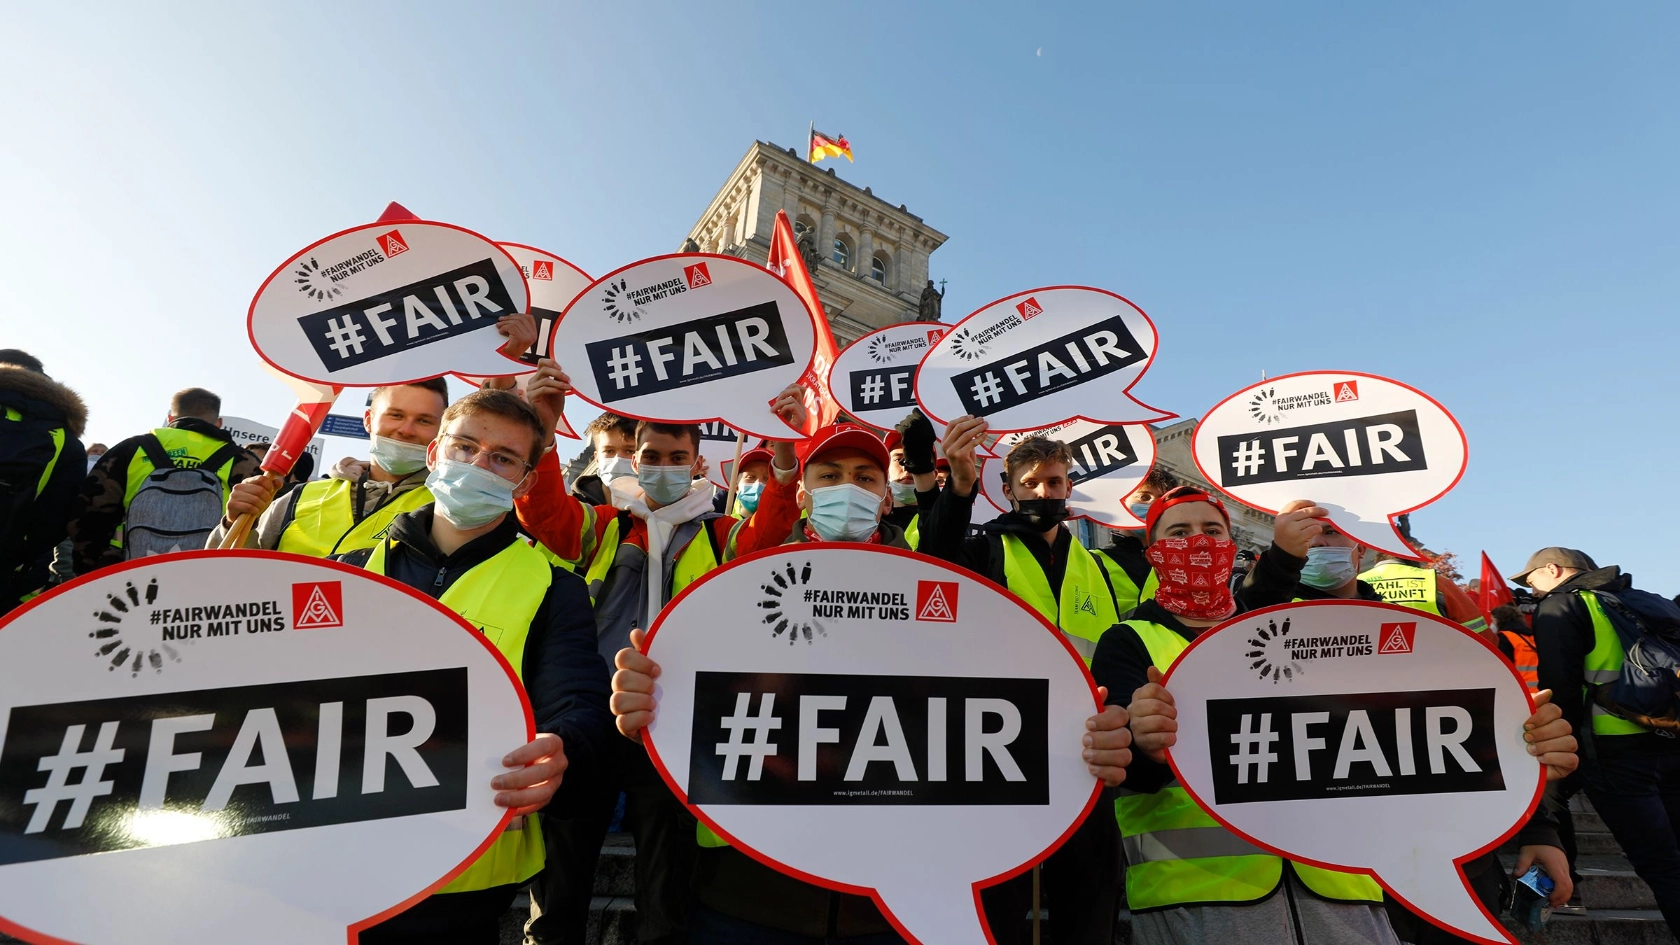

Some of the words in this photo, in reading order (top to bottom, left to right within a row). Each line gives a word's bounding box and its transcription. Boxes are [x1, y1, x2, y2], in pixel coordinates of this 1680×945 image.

[320, 248, 379, 278] #FAIRWANDEL
[330, 270, 350, 283] NUR
[350, 263, 368, 275] MIT
[367, 254, 385, 268] UNS
[626, 278, 684, 300] #FAIRWANDEL
[634, 295, 652, 306] NUR
[653, 290, 668, 301] MIT
[670, 284, 687, 296] UNS
[324, 274, 504, 359] #FAIR
[970, 314, 1018, 342] #FAIRWANDEL
[885, 337, 926, 349] #FAIRWANDEL
[977, 335, 994, 345] NUR
[994, 328, 1007, 338] MIT
[1006, 318, 1022, 330] UNS
[606, 316, 780, 390] #FAIR
[970, 330, 1132, 408] #FAIR
[1272, 391, 1330, 405] #FAIRWANDEL
[1278, 403, 1295, 411] NUR
[1296, 400, 1312, 409] MIT
[1313, 397, 1331, 407] UNS
[1231, 423, 1412, 477] #FAIR
[1407, 580, 1426, 588] IST
[803, 589, 908, 606] #FAIRWANDEL
[150, 600, 282, 625] #FAIRWANDEL
[812, 604, 844, 618] NUR
[847, 605, 876, 619] MIT
[878, 606, 910, 620] UNS
[162, 624, 202, 641] NUR
[207, 620, 242, 638] MIT
[246, 616, 286, 634] UNS
[1283, 634, 1372, 650] #FAIRWANDEL
[1291, 649, 1318, 660] NUR
[1320, 647, 1343, 658] MIT
[1346, 645, 1373, 657] UNS
[715, 692, 1028, 781] #FAIR
[1229, 705, 1483, 784] #FAIR
[23, 695, 440, 834] #FAIR
